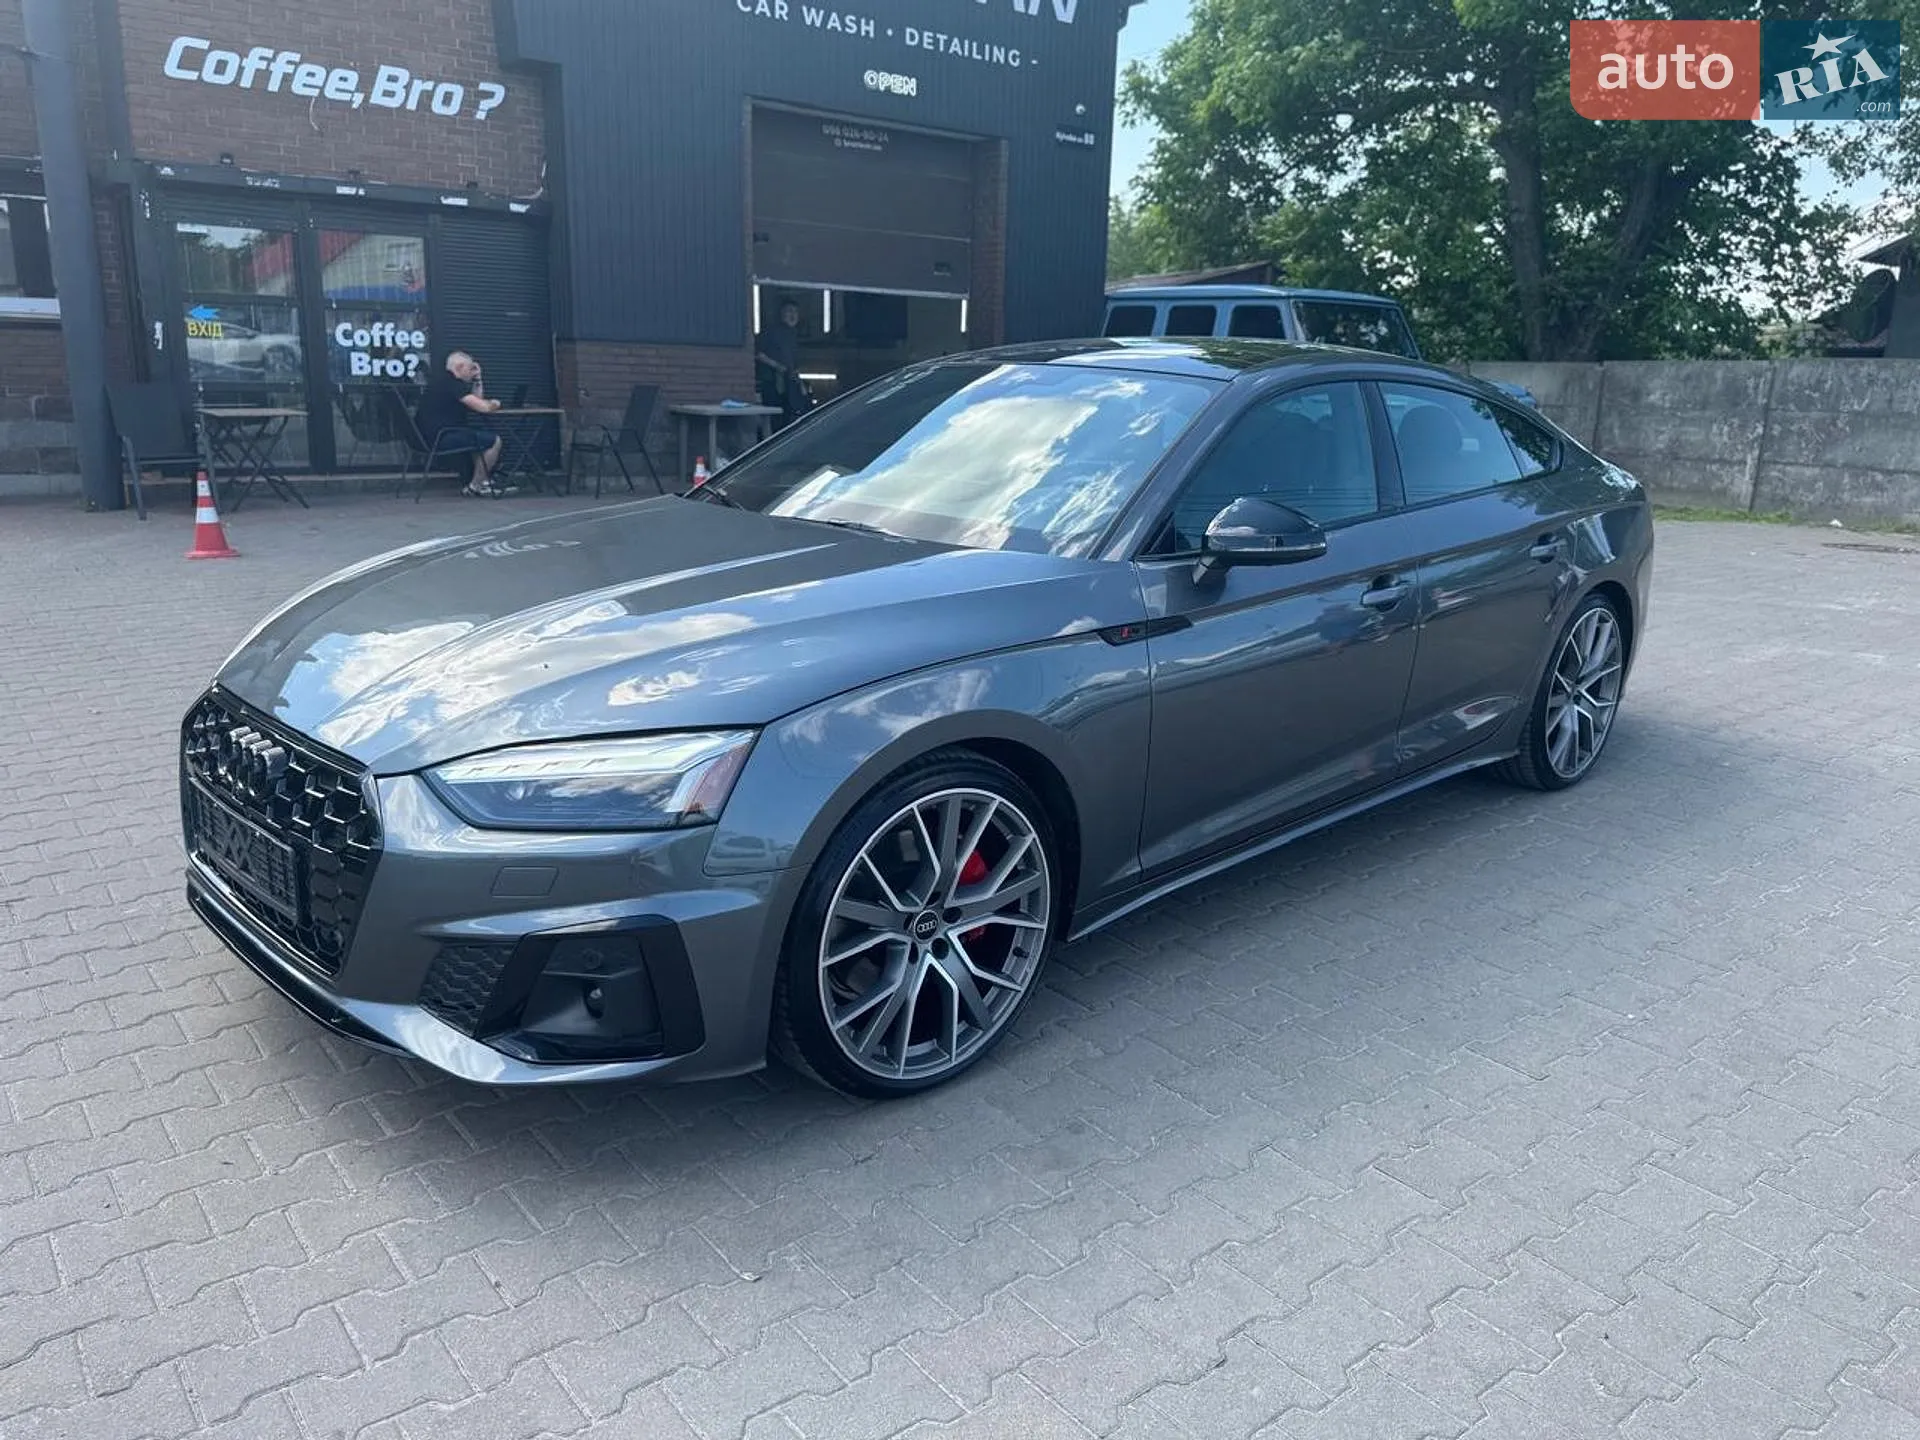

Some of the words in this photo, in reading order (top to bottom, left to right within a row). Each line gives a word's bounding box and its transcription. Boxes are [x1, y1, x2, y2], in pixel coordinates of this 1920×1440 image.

[736, 0, 788, 21] CAR
[801, 6, 875, 38] WASH
[905, 27, 1021, 67] DETAILING
[863, 70, 917, 97] OPEN
[187, 320, 225, 340] ВХІД
[335, 322, 425, 349] Coffee
[350, 351, 420, 378] Bro?
